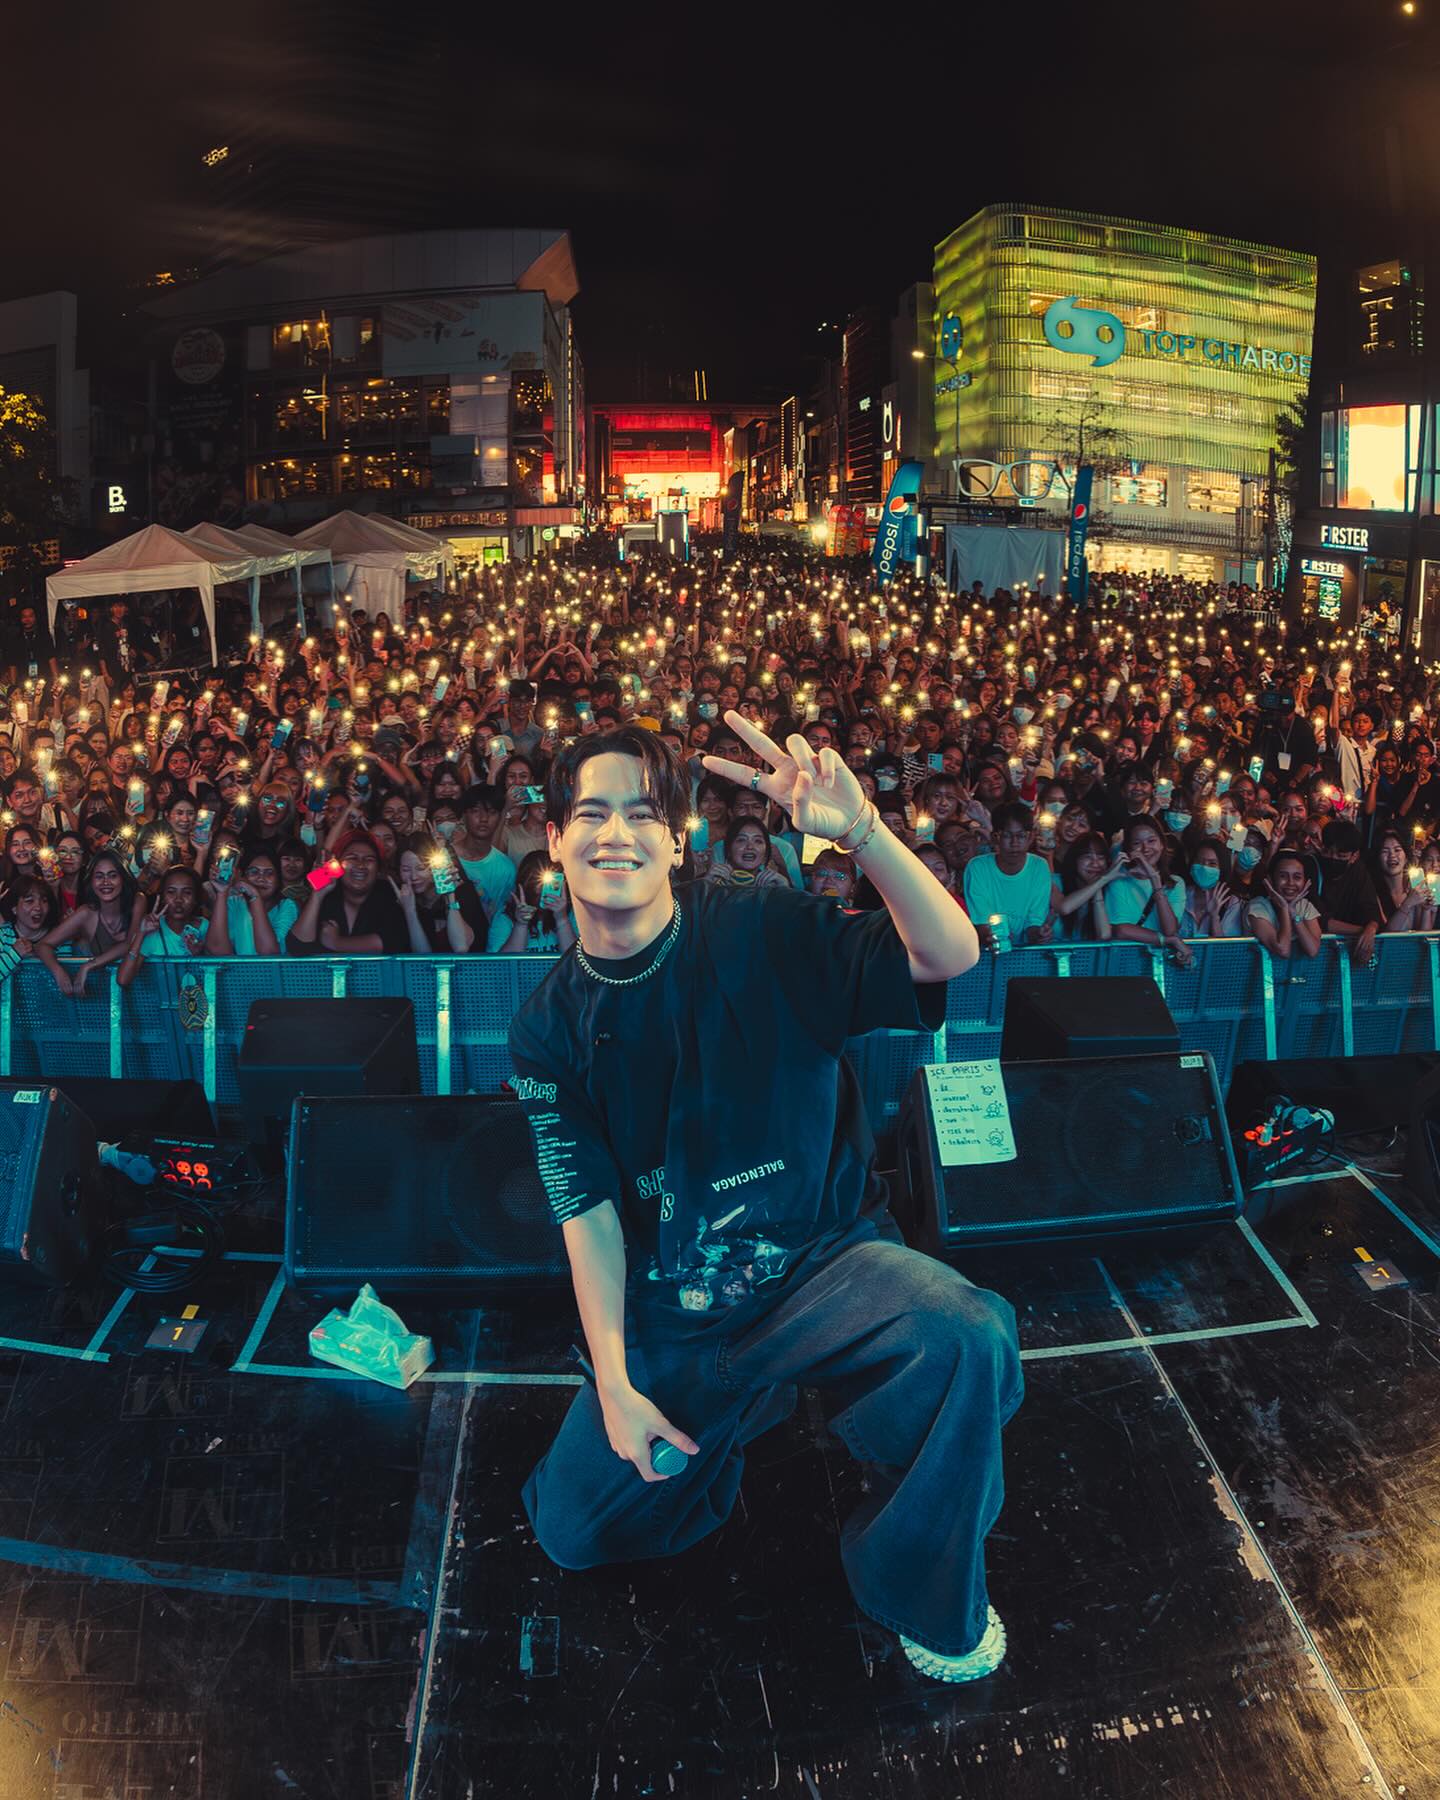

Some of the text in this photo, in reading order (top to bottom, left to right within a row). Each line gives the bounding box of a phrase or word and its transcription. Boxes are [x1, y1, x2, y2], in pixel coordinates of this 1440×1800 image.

[1139, 328, 1313, 378] TOP CHAROE
[879, 522, 900, 575] pepsi
[1071, 529, 1083, 578] pepsi
[930, 1066, 946, 1077] ICE
[952, 1064, 981, 1076] PARIS
[711, 1158, 786, 1193] BALENCIAGA
[172, 1326, 184, 1341] 1
